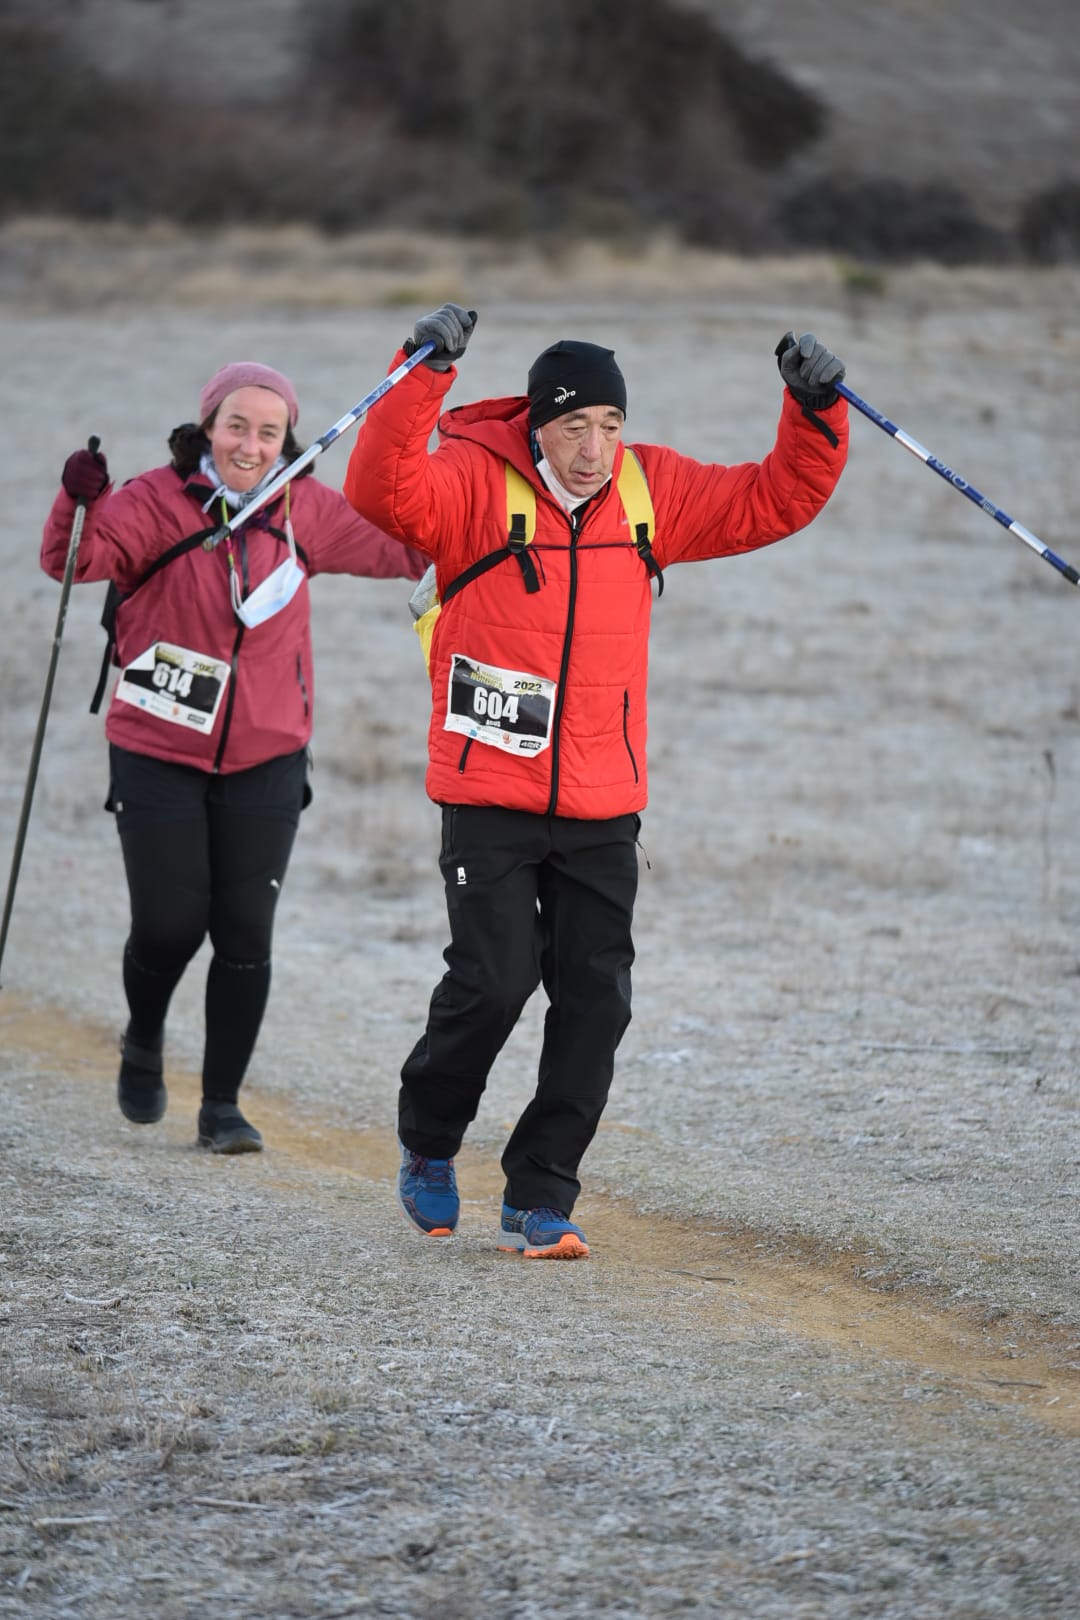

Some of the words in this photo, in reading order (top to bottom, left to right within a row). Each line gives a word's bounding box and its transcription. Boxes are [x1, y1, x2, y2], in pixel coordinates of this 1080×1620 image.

[554, 387, 576, 404] spyro
[152, 662, 194, 698] 614
[513, 680, 542, 692] 2022
[473, 686, 519, 724] 604
